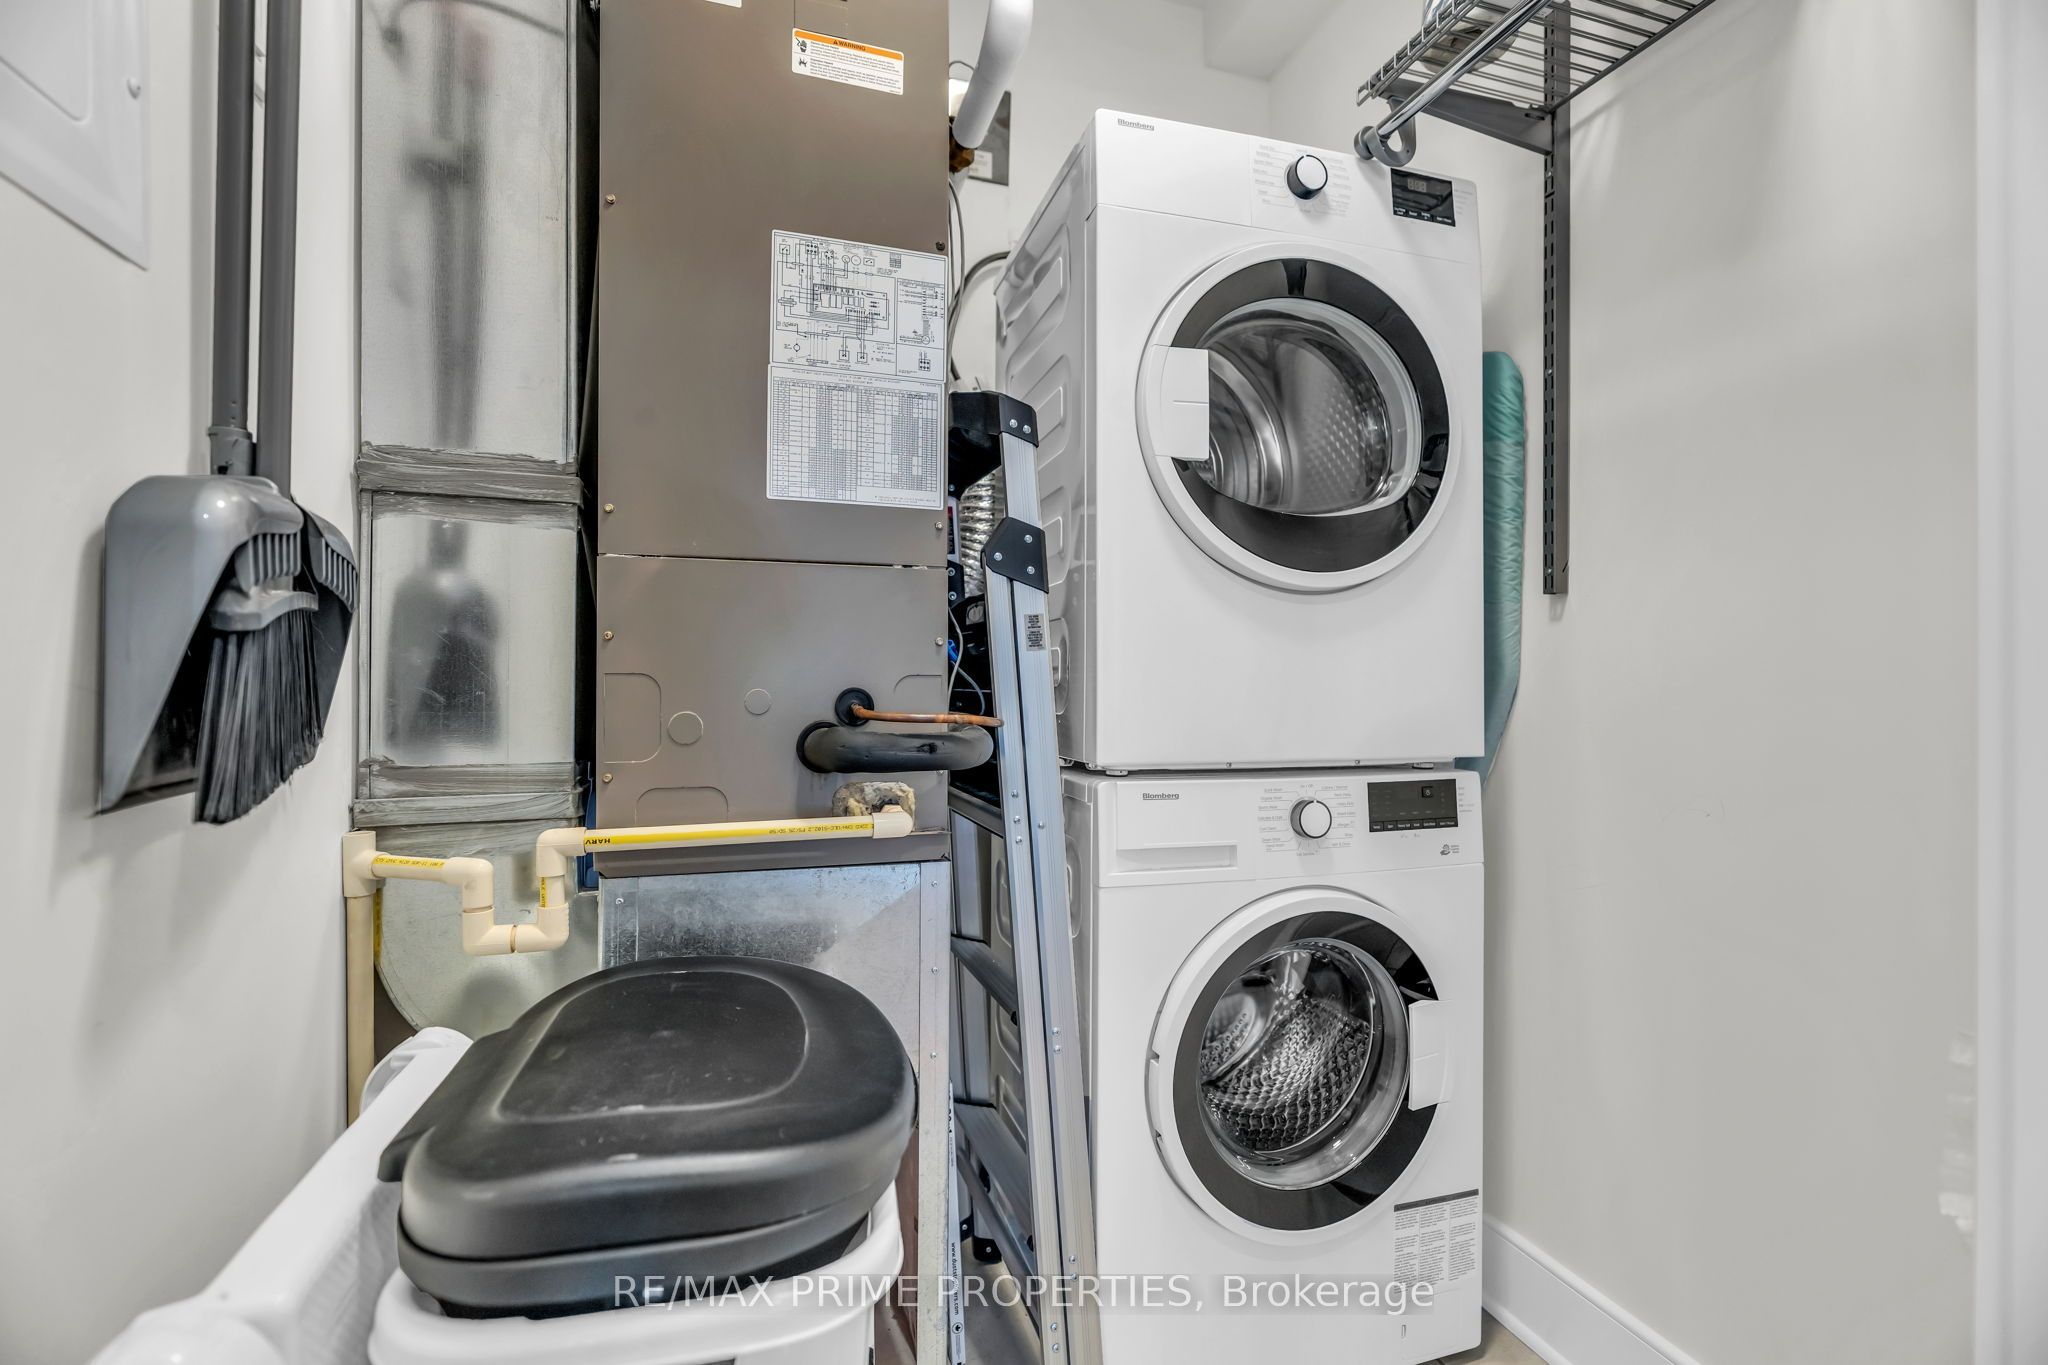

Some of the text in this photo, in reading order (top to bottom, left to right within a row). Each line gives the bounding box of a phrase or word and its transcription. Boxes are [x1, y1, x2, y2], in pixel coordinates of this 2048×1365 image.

[838, 40, 866, 51] WARNING
[1117, 118, 1154, 131] Blomberg
[1142, 792, 1180, 800] Blomberg
